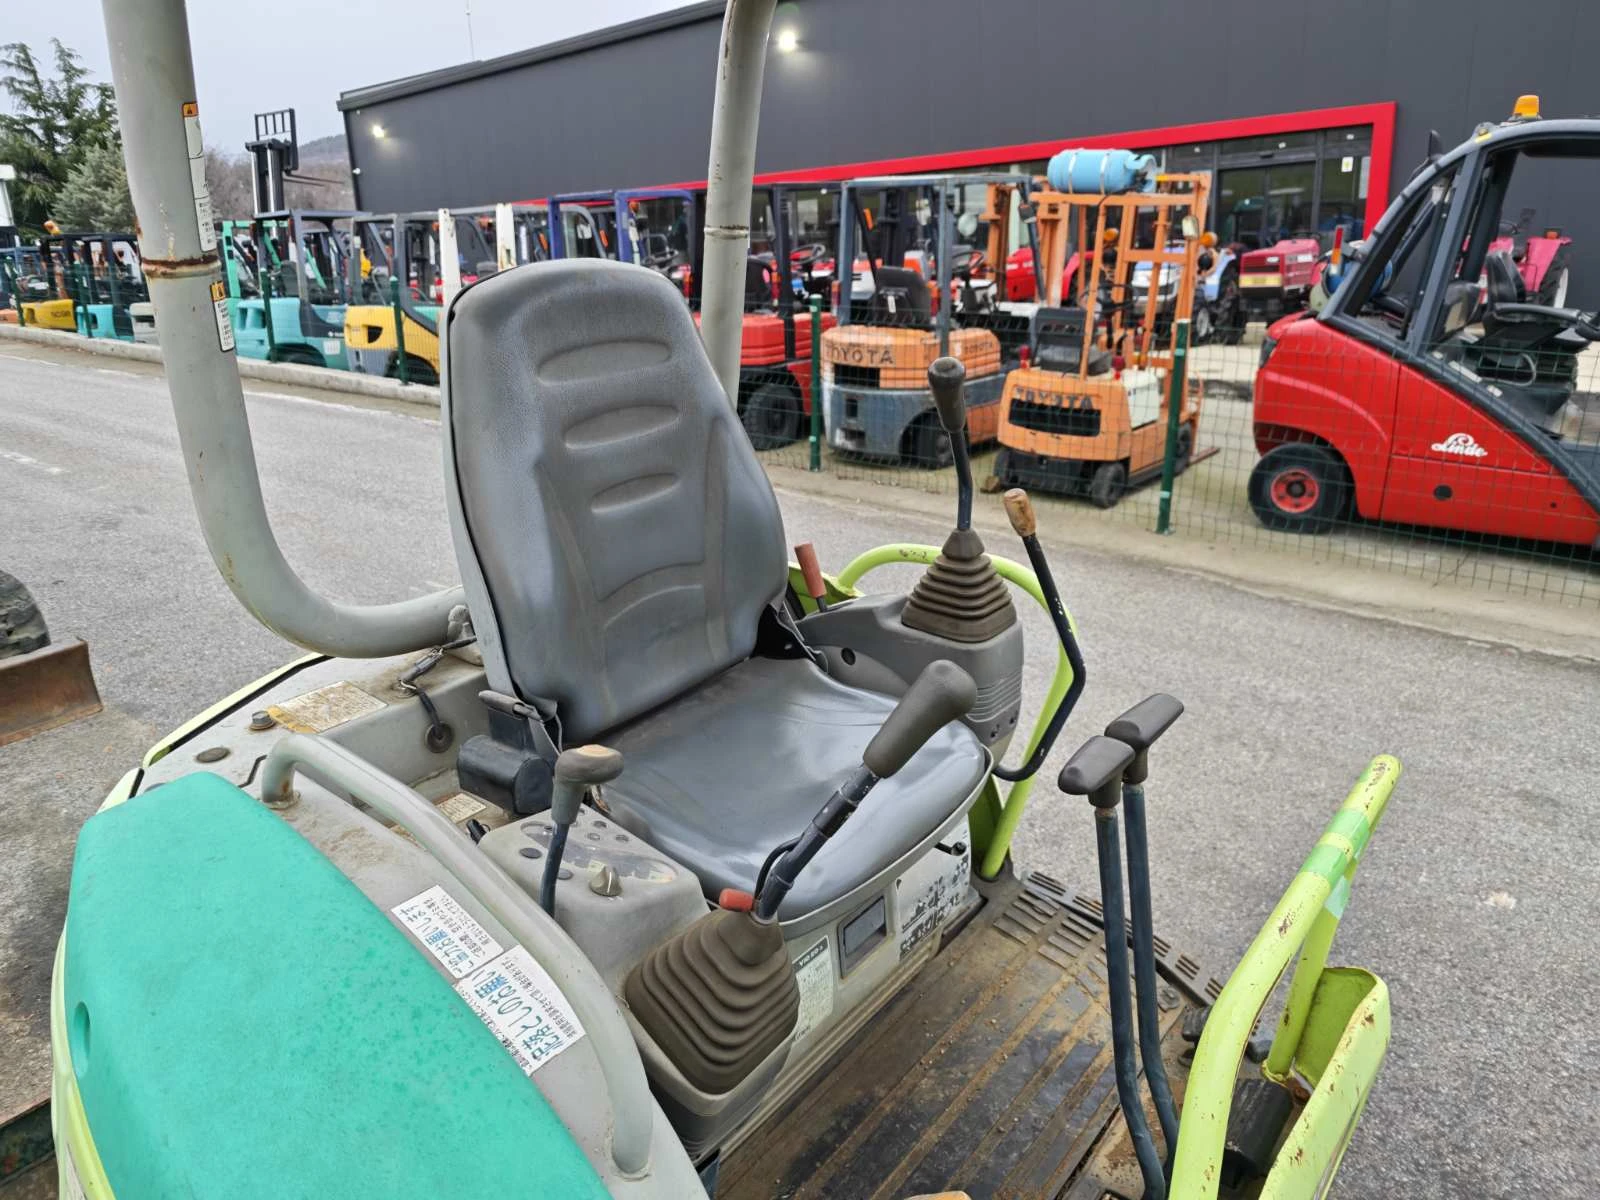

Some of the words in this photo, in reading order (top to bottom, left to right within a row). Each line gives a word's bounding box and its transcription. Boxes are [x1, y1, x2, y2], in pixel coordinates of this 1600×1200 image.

[825, 343, 895, 365] TOYOTA
[1015, 386, 1094, 411] TOYOTA
[1431, 432, 1489, 458] Linde
[471, 968, 565, 1061] 泥落としのお願い
